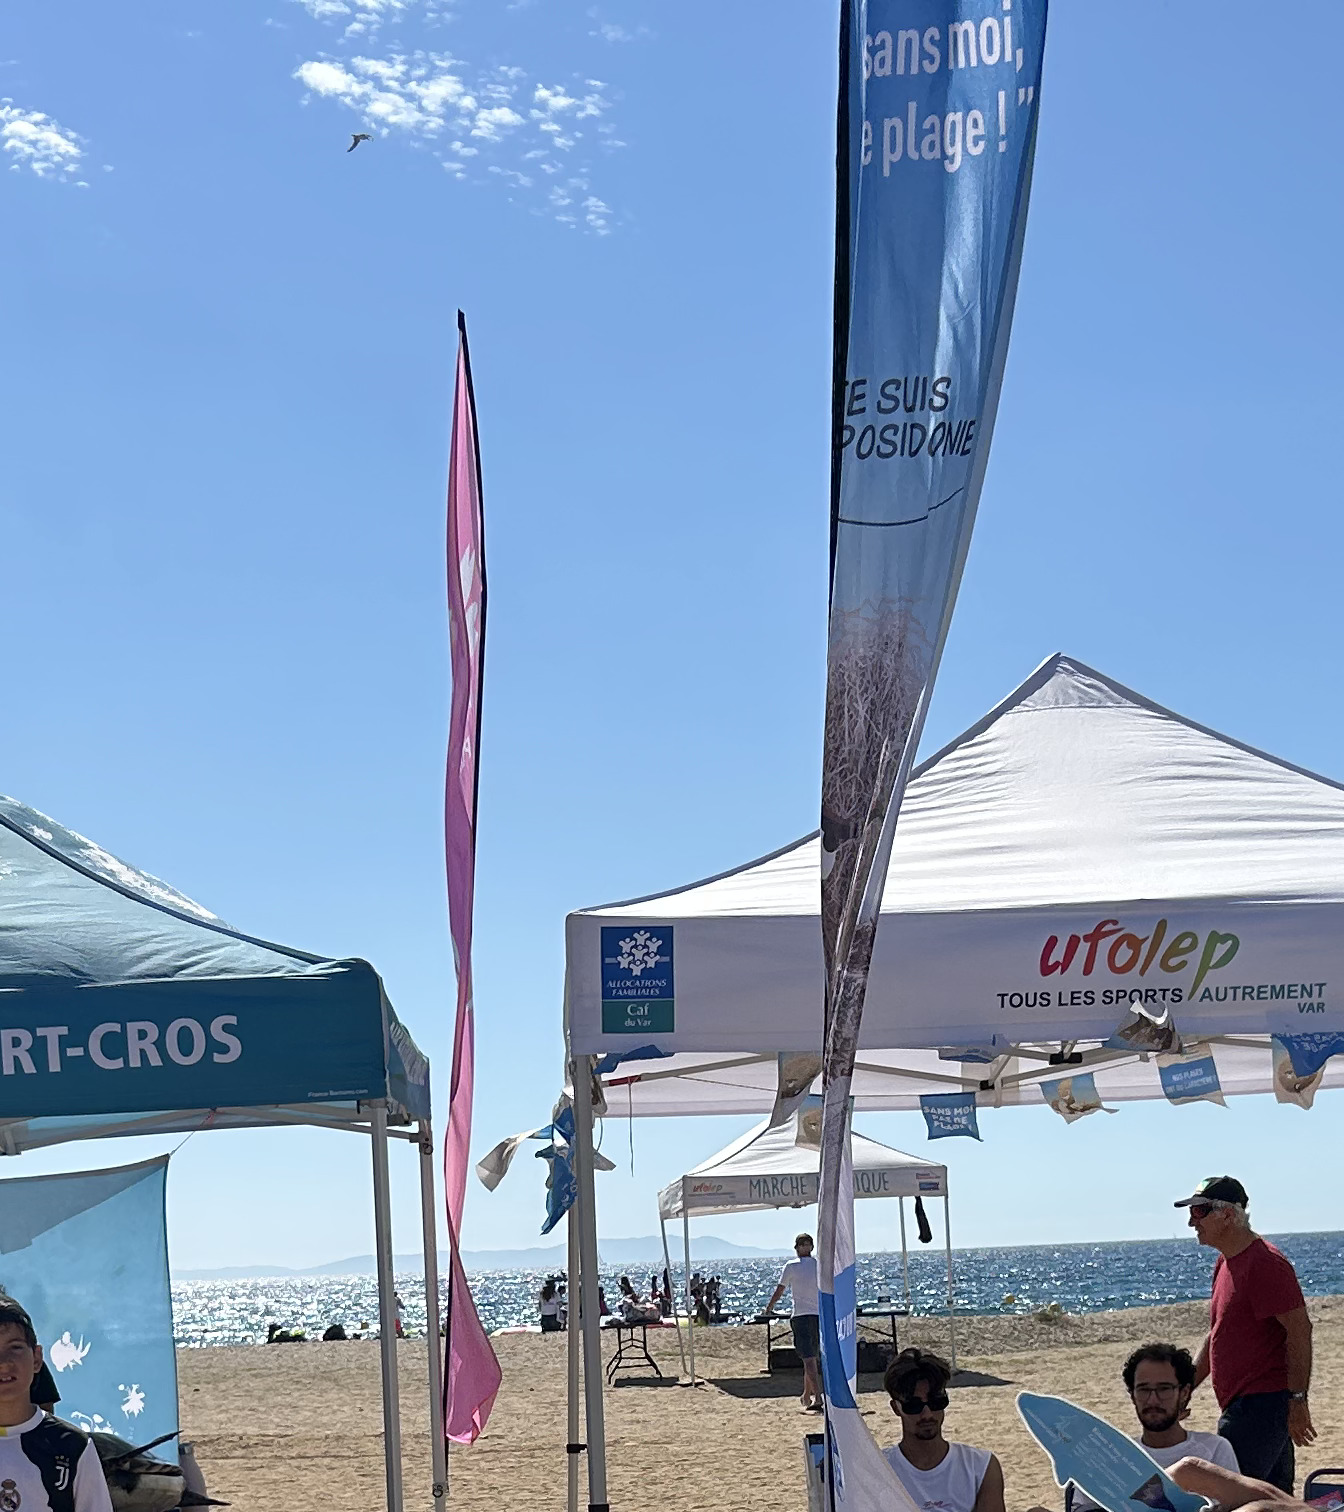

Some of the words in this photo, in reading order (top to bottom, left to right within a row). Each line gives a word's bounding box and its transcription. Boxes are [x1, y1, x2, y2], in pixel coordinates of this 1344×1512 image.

[862, 27, 941, 80] sans
[948, 0, 1023, 73] moi,
[860, 120, 873, 166] e
[883, 101, 986, 177] plage
[845, 378, 867, 416] E
[877, 376, 951, 415] SUIS
[842, 420, 976, 460] POSIDONIE
[1039, 918, 1241, 1000] ufolep
[607, 979, 667, 988] ALLOCATIONS
[612, 987, 660, 996] FAMILIALES
[997, 991, 1051, 1008] TOUS
[1058, 989, 1096, 1006] LES
[1101, 987, 1183, 1005] SPORTS
[1199, 982, 1327, 1002] AUTREMENT
[627, 1003, 650, 1016] Caf
[1297, 1002, 1326, 1013] VAR
[624, 1018, 635, 1027] du
[637, 1018, 652, 1027] Var
[923, 1106, 951, 1115] SANS
[954, 1104, 975, 1115] MOI
[749, 1176, 808, 1199] MARCHE
